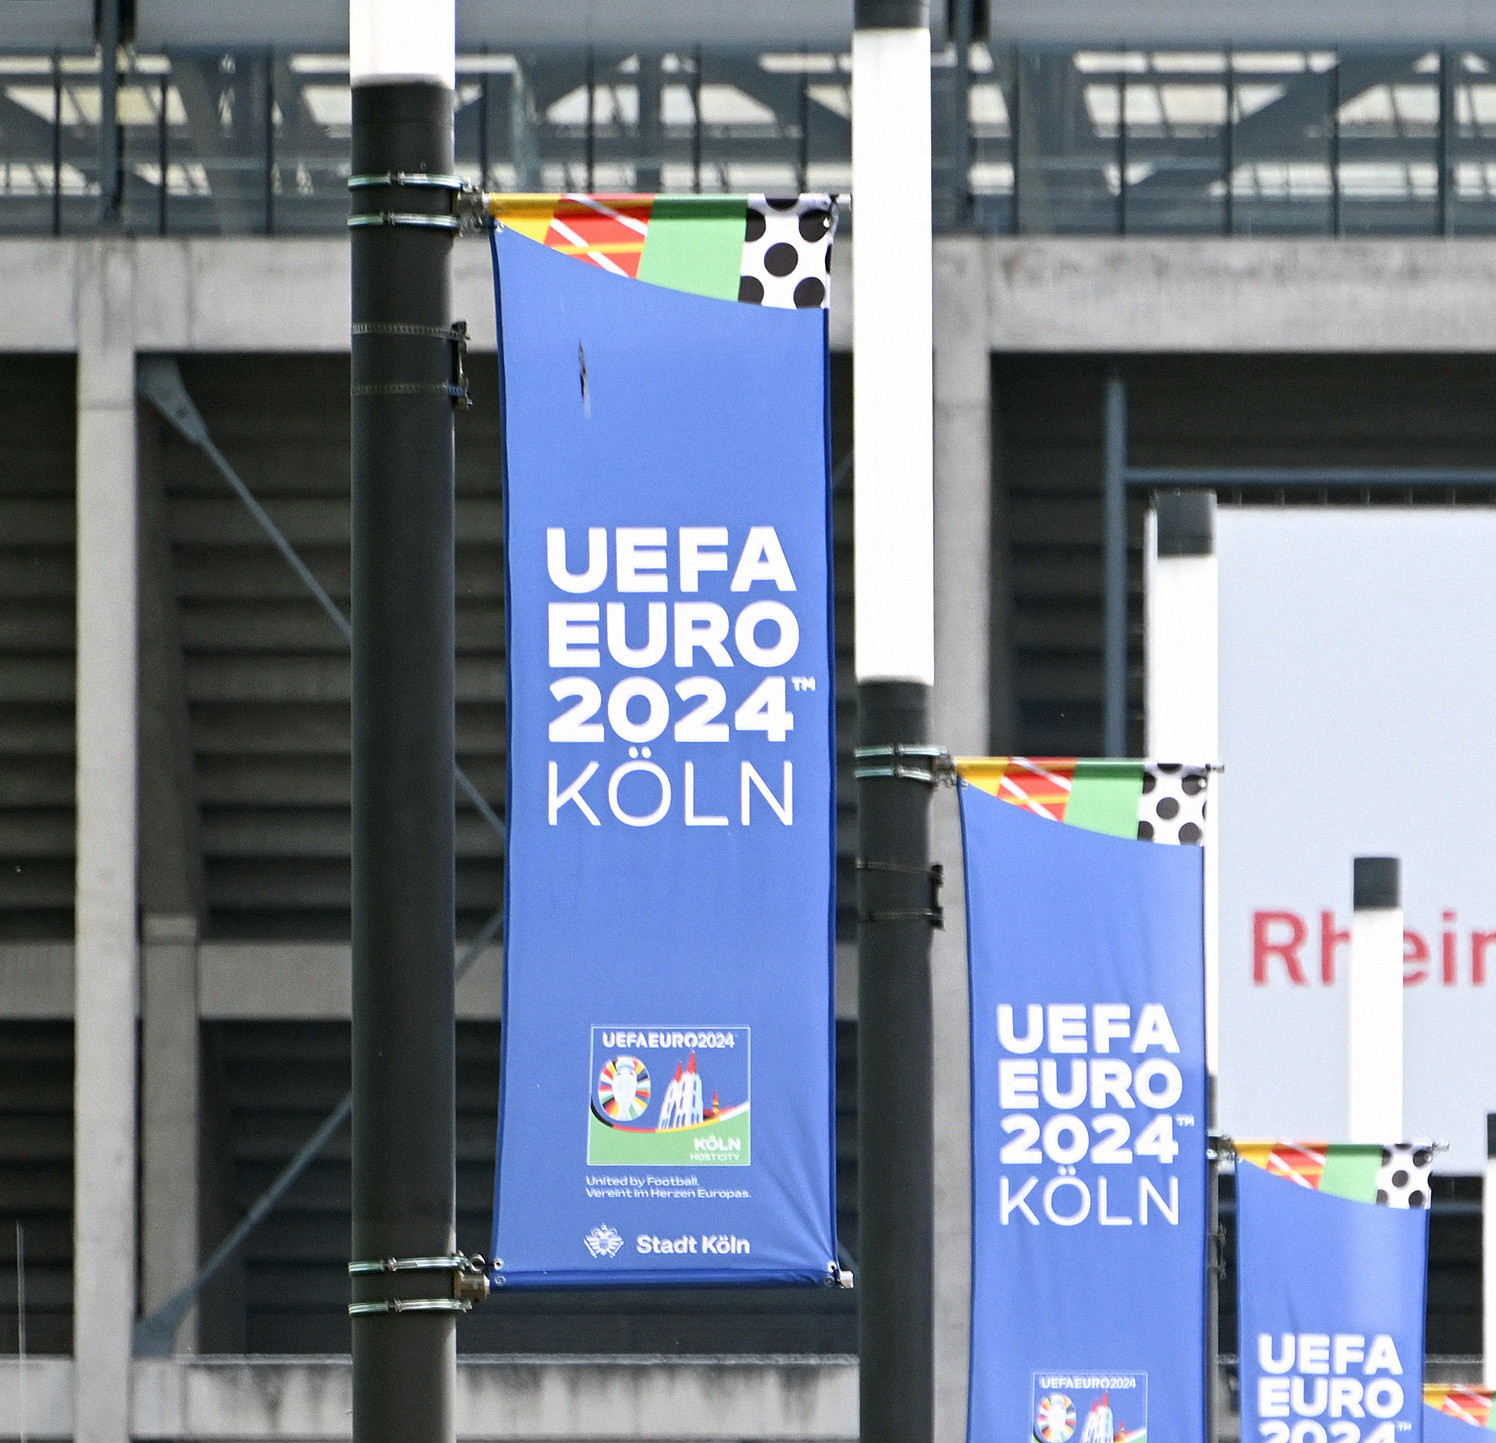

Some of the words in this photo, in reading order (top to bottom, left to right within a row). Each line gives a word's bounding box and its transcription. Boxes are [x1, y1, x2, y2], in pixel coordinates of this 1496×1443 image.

[546, 526, 797, 593] UEFA
[547, 601, 799, 668] EURO
[547, 746, 795, 827] KÖLN
[996, 1004, 1181, 1053] UEFA
[998, 1059, 1182, 1109] EURO
[694, 1136, 741, 1151] KÖLN
[586, 1176, 629, 1187] United
[630, 1176, 645, 1188] by
[647, 1176, 701, 1187] Football.
[586, 1188, 633, 1199] Vereint
[634, 1188, 649, 1198] im
[651, 1188, 696, 1199] Herzen
[698, 1188, 752, 1200] Europas.
[998, 1167, 1180, 1226] KÖLN
[636, 1234, 697, 1254] Stadt
[702, 1234, 750, 1254] Köln
[1257, 1333, 1404, 1376] UEFA
[1257, 1376, 1405, 1419] EURO
